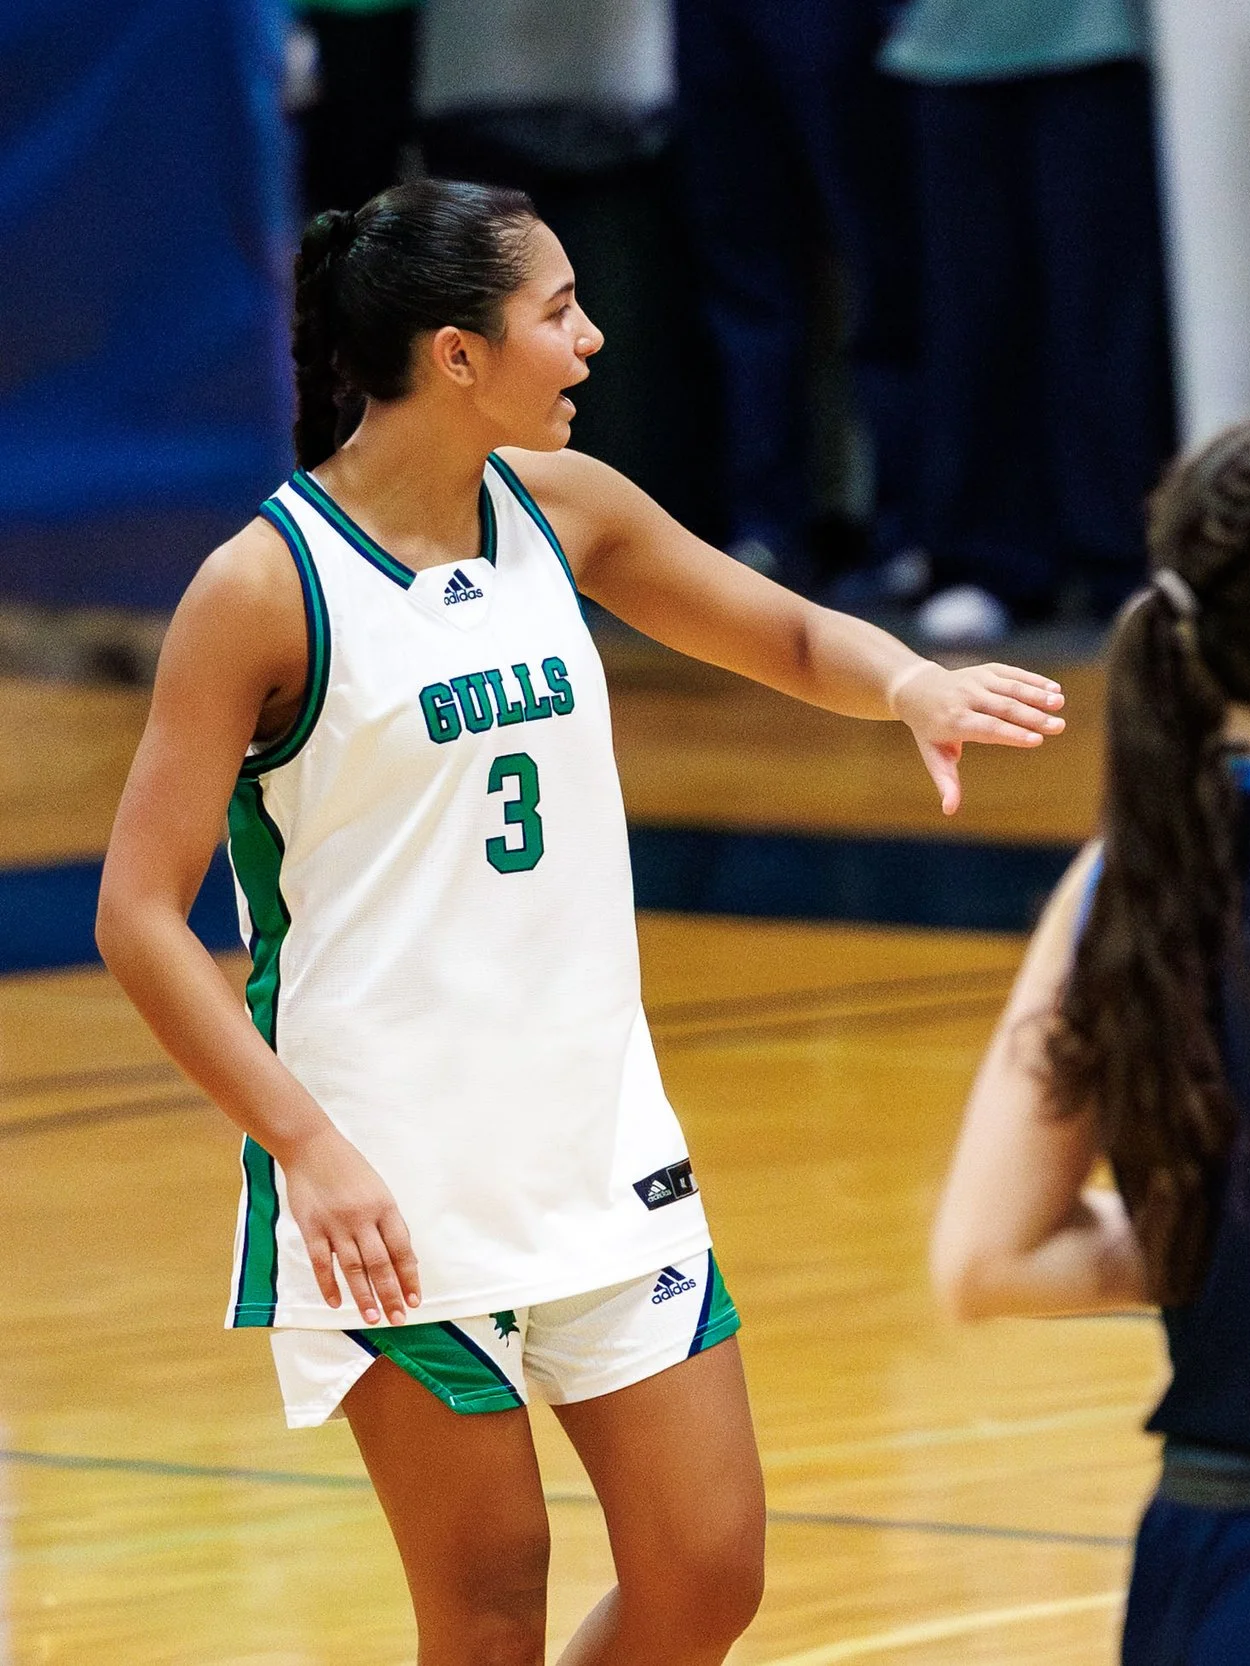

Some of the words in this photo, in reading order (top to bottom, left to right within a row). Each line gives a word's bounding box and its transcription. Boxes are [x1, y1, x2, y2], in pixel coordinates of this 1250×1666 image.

[443, 587, 484, 606] adidas
[418, 656, 575, 744] GULLS
[485, 752, 545, 875] 3
[651, 1278, 697, 1305] adidas
